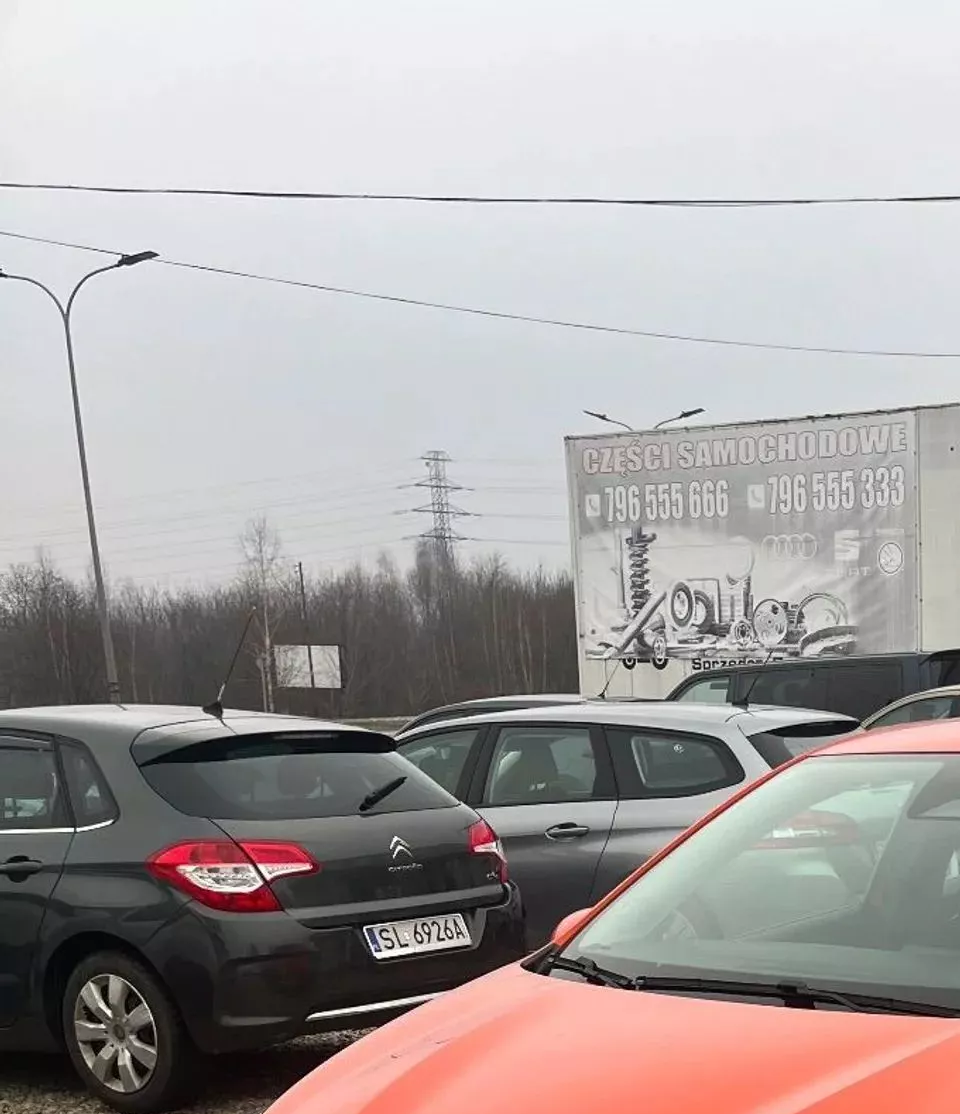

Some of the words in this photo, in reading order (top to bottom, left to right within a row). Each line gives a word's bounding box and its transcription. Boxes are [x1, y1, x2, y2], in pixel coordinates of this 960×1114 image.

[582, 440, 671, 478] CZĘŚCI
[677, 422, 907, 469] SAMOCHODOWE
[605, 485, 641, 523] 796
[645, 482, 683, 521] 555
[688, 479, 729, 518] 666
[767, 473, 806, 514] 796
[812, 469, 854, 512] 555
[860, 465, 905, 509] 333
[379, 927, 409, 950] SL
[413, 917, 466, 944] 6926A
